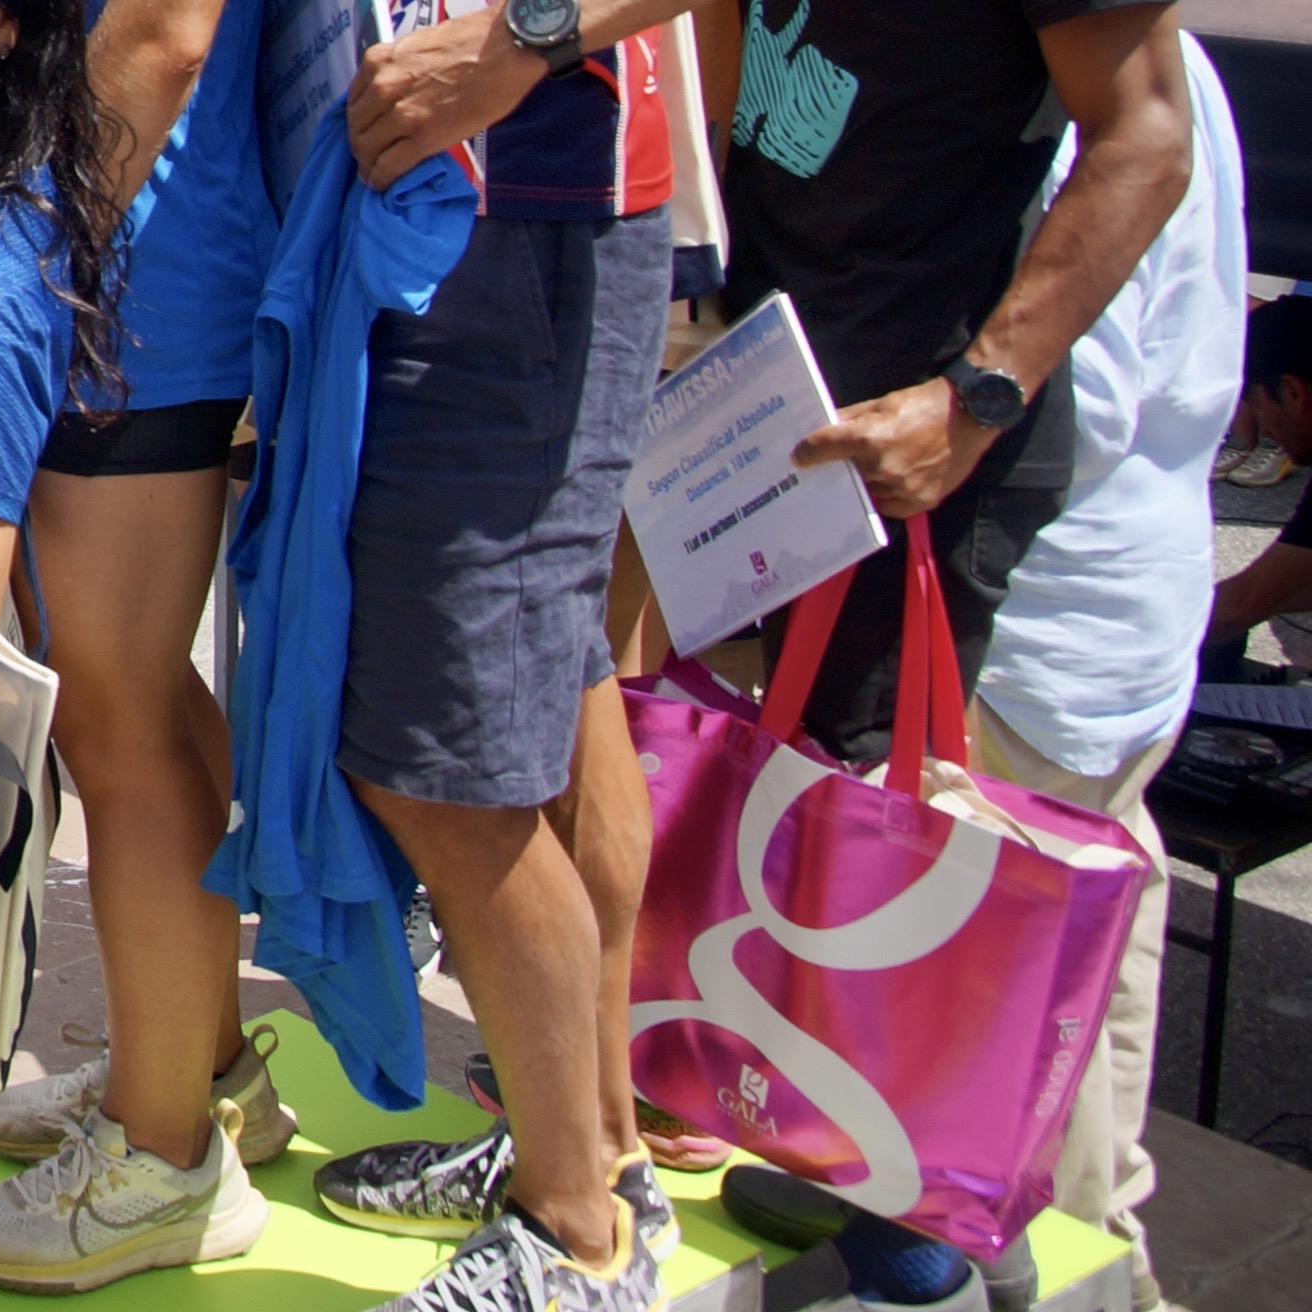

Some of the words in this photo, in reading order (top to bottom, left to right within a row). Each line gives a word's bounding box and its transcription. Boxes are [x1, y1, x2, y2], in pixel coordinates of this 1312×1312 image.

[679, 428, 736, 474] Classificat
[736, 393, 786, 438] Absoluta
[743, 445, 761, 464] km
